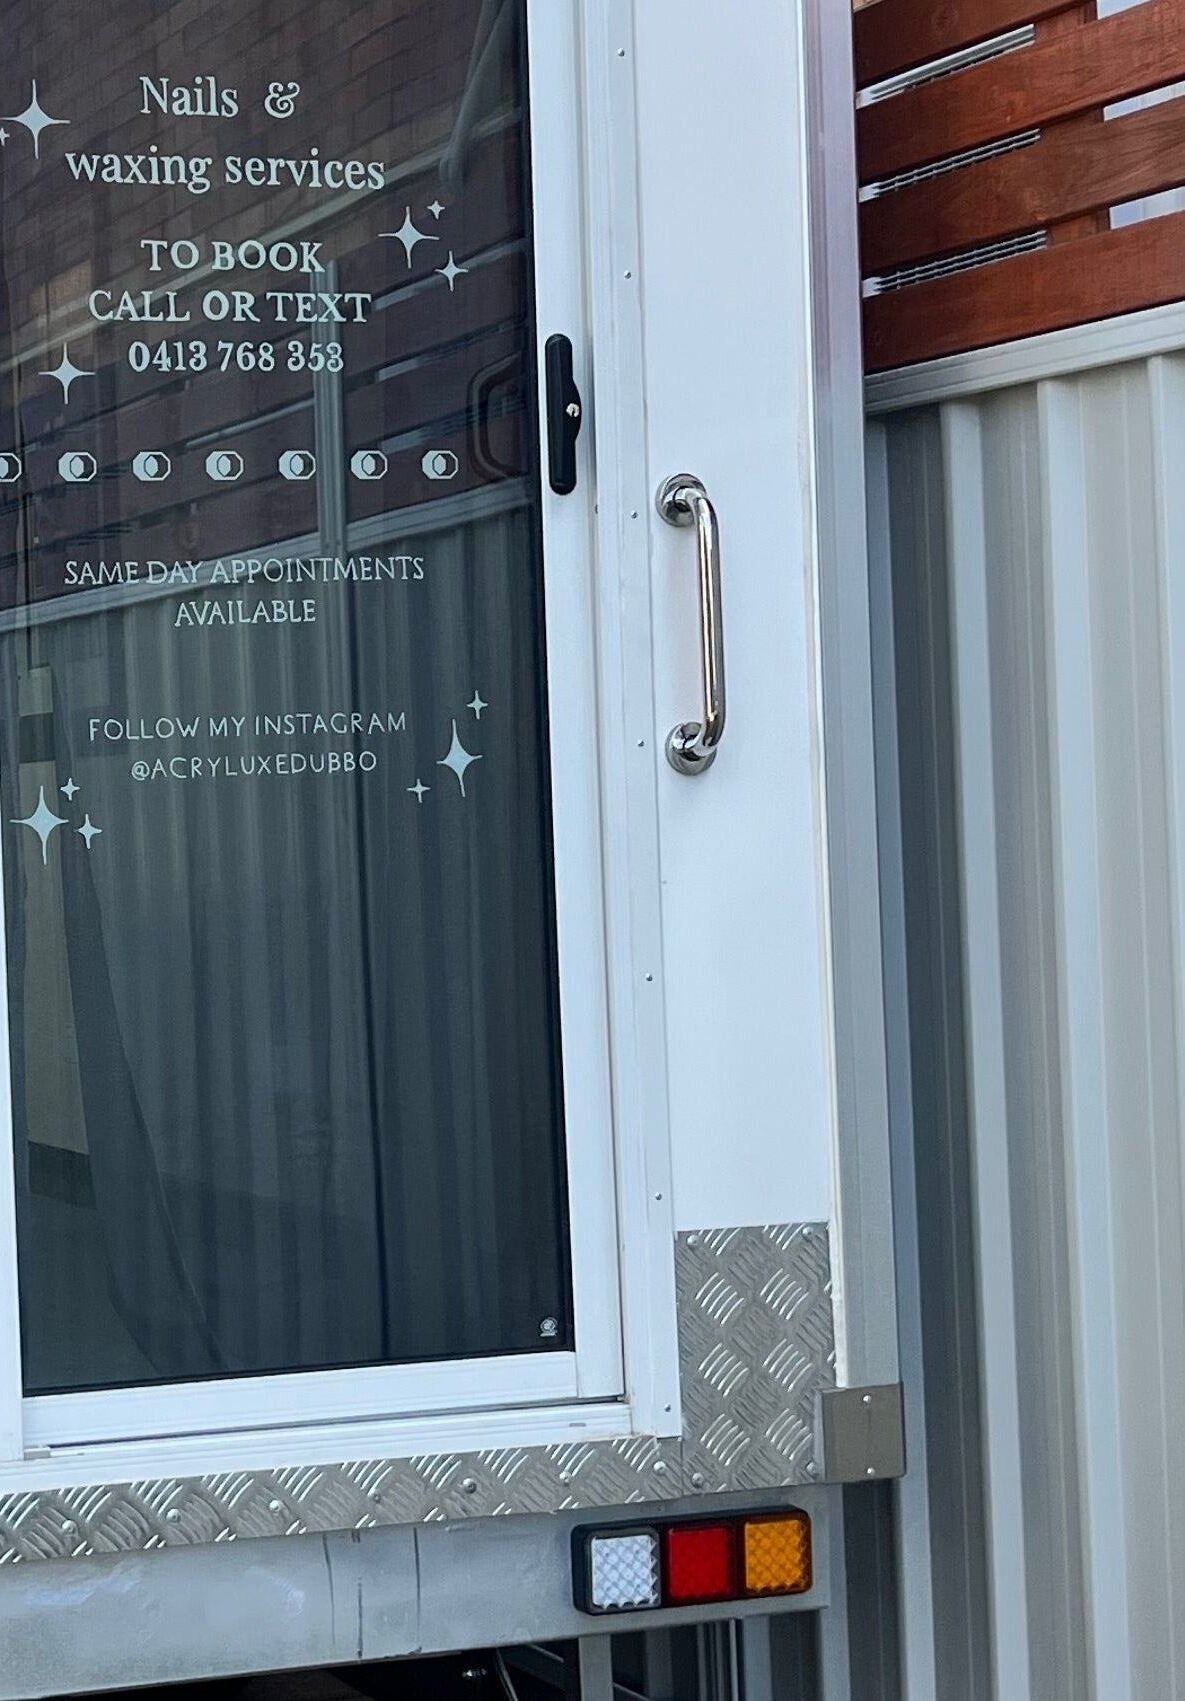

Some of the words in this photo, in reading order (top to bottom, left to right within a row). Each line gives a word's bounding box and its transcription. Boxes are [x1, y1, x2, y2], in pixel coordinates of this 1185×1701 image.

[139, 76, 239, 117] Nails
[263, 81, 301, 118] &
[65, 145, 213, 194] waxing
[224, 147, 386, 190] services
[140, 239, 200, 271] TO
[211, 240, 326, 273] BOOK
[88, 290, 190, 322] CALL
[202, 290, 260, 322] OR
[266, 292, 372, 323] TEXT
[128, 340, 208, 373] 0413
[217, 340, 276, 372] 768
[286, 340, 345, 373] 353
[63, 560, 139, 586] SAME
[145, 560, 202, 584] DAY
[208, 556, 425, 584] APPOINTMENTS
[174, 600, 316, 627] AVAILABLE
[89, 716, 201, 742] FOLLOW
[208, 716, 246, 737] MY
[255, 711, 407, 736] INSTAGRAM
[131, 750, 377, 782] @ACRYLUXEDUBBO
